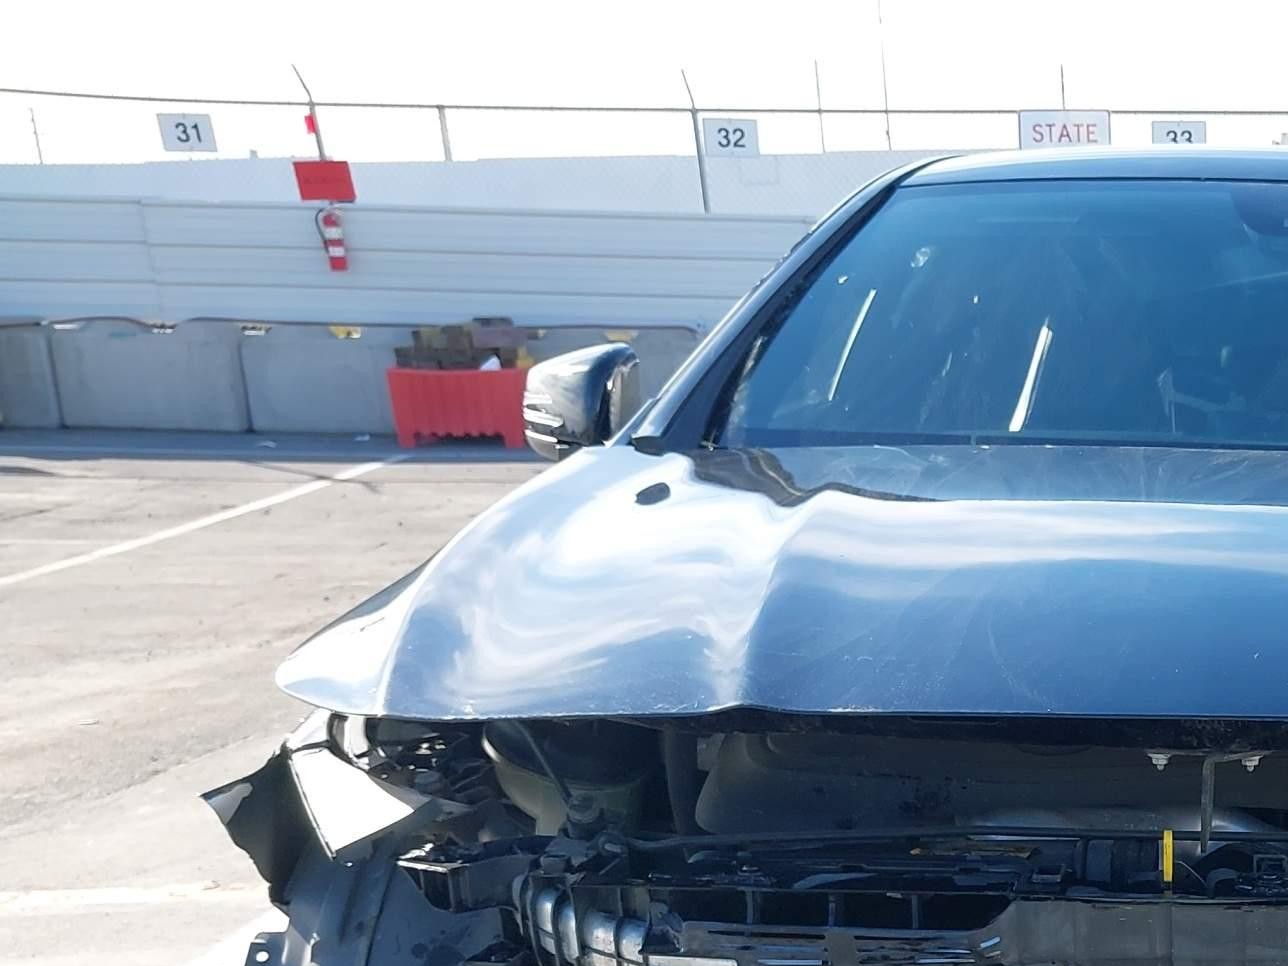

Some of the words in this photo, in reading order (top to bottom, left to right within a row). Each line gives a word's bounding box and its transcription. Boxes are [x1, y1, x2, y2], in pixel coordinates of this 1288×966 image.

[175, 122, 202, 143] 31
[717, 127, 746, 148] 32
[1032, 123, 1098, 144] STATE
